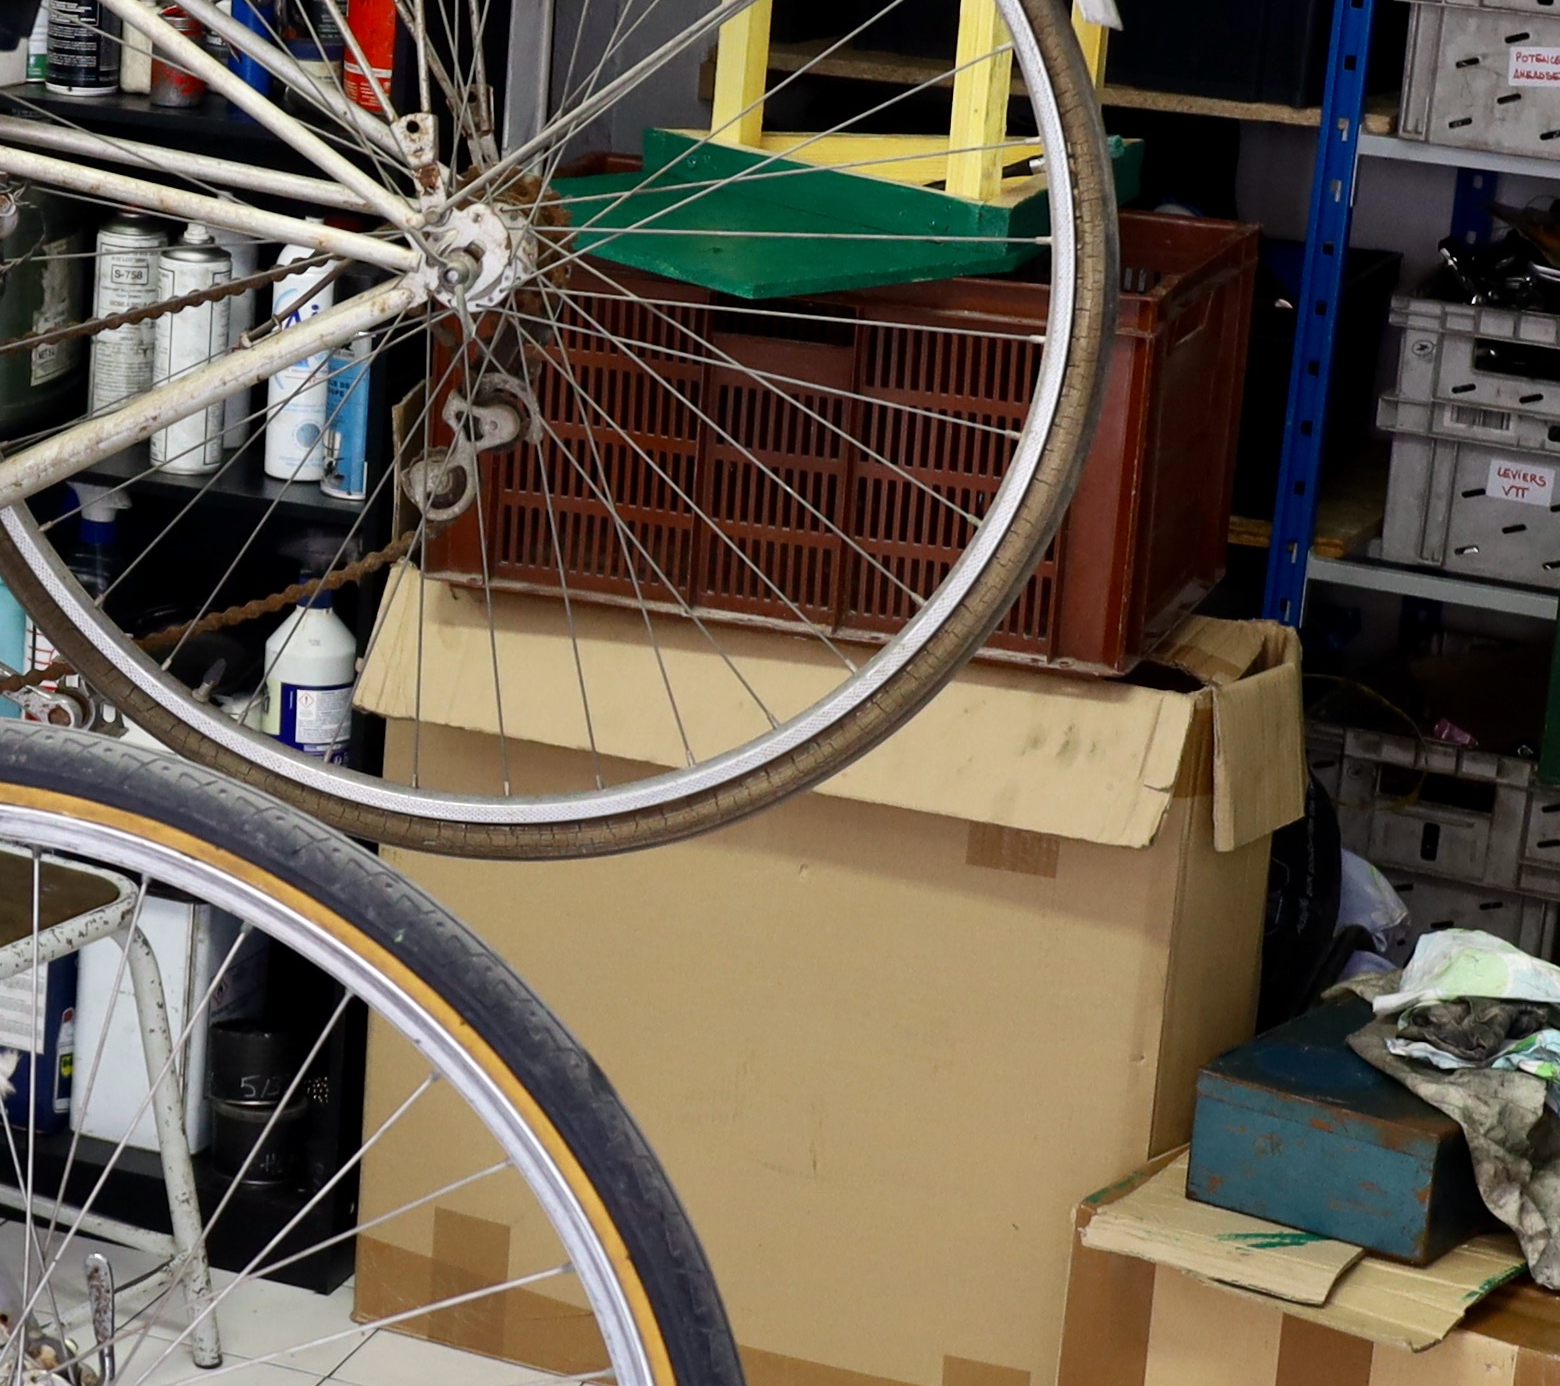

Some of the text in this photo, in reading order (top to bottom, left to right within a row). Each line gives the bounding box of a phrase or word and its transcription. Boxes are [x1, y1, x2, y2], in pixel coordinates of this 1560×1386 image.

[113, 269, 144, 282] S-758
[1497, 467, 1547, 487] LEVIERS
[1502, 486, 1530, 499] VTT
